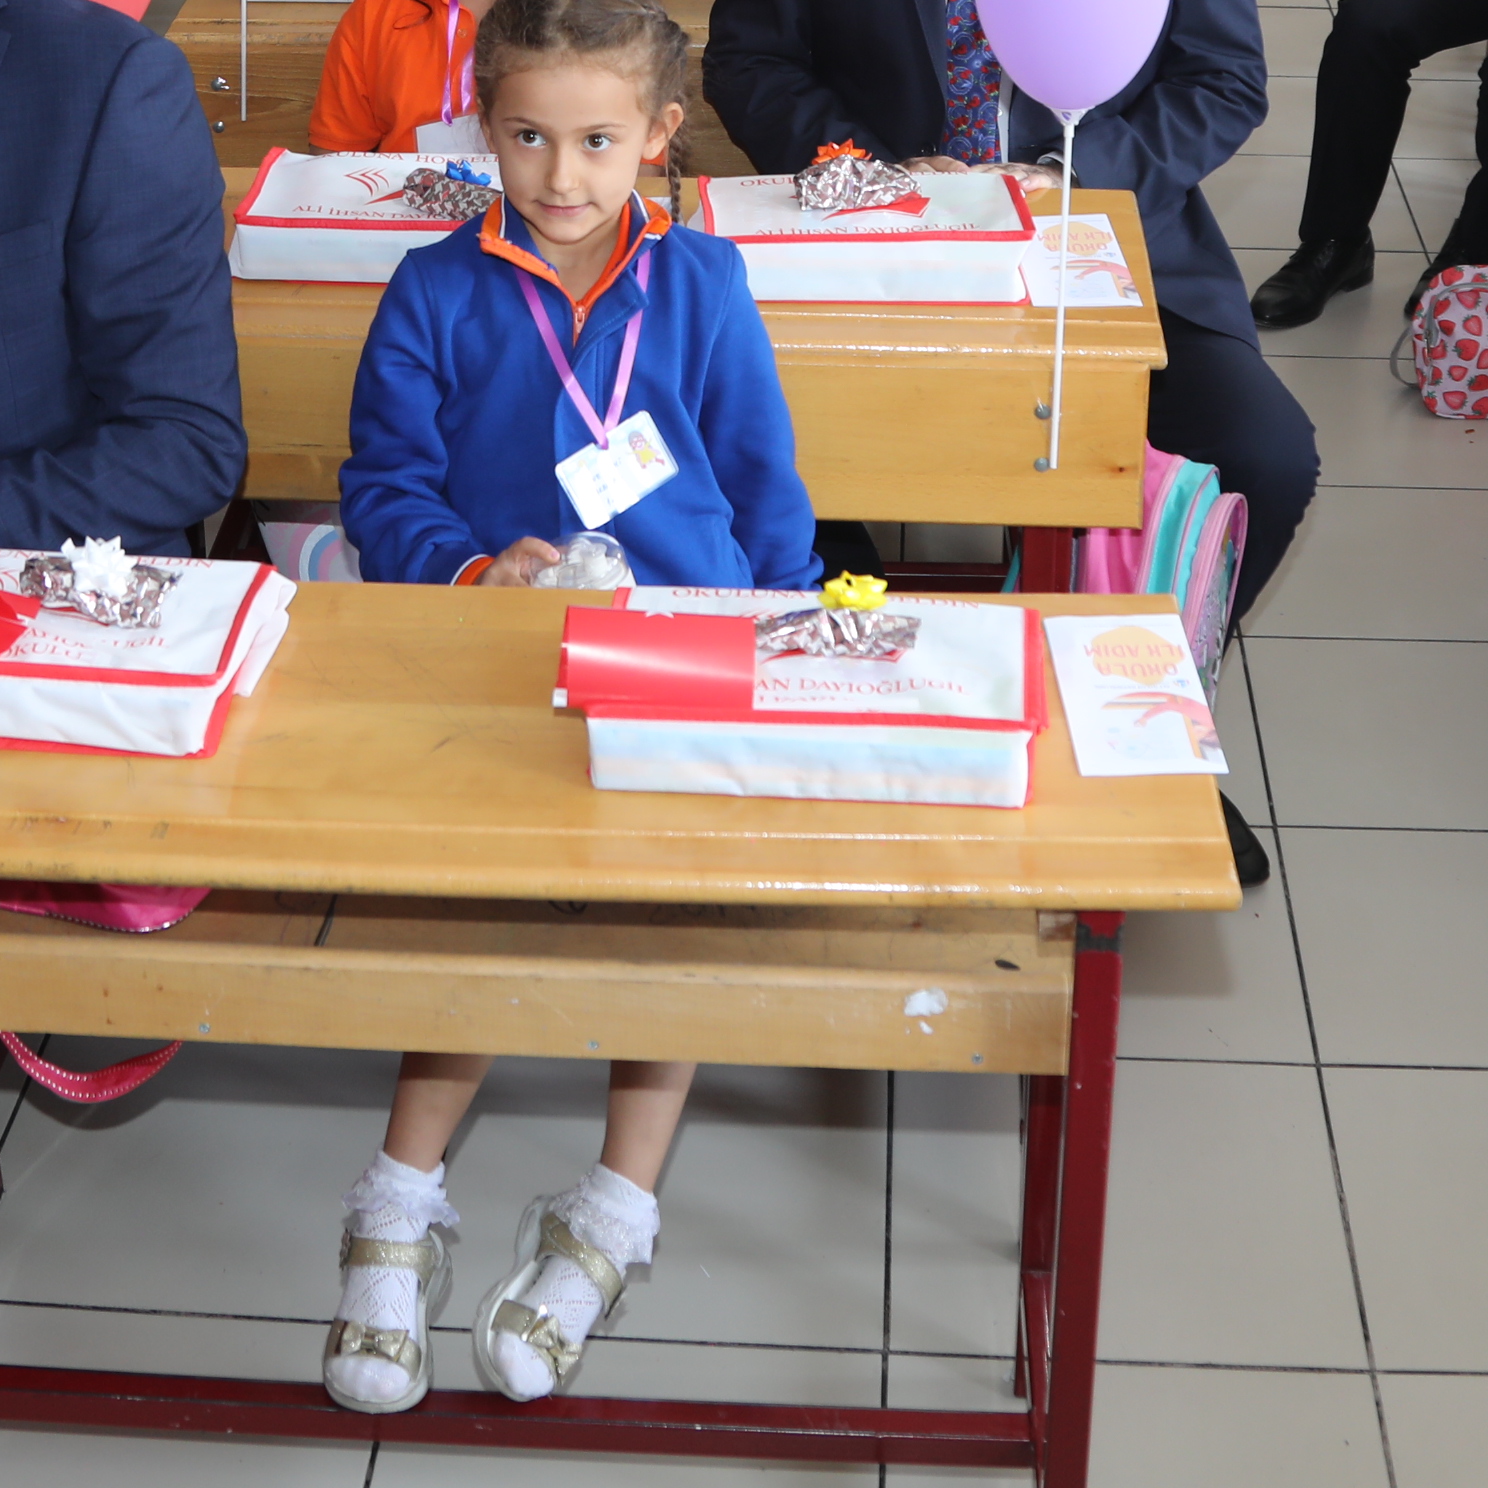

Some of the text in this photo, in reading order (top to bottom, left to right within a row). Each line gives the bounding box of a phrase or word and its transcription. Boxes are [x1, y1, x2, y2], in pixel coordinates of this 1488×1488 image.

[292, 205, 323, 214] ALİ
[329, 206, 386, 219] İHSAN
[672, 587, 807, 599] OKULUNA
[1083, 643, 1138, 658] ADIM
